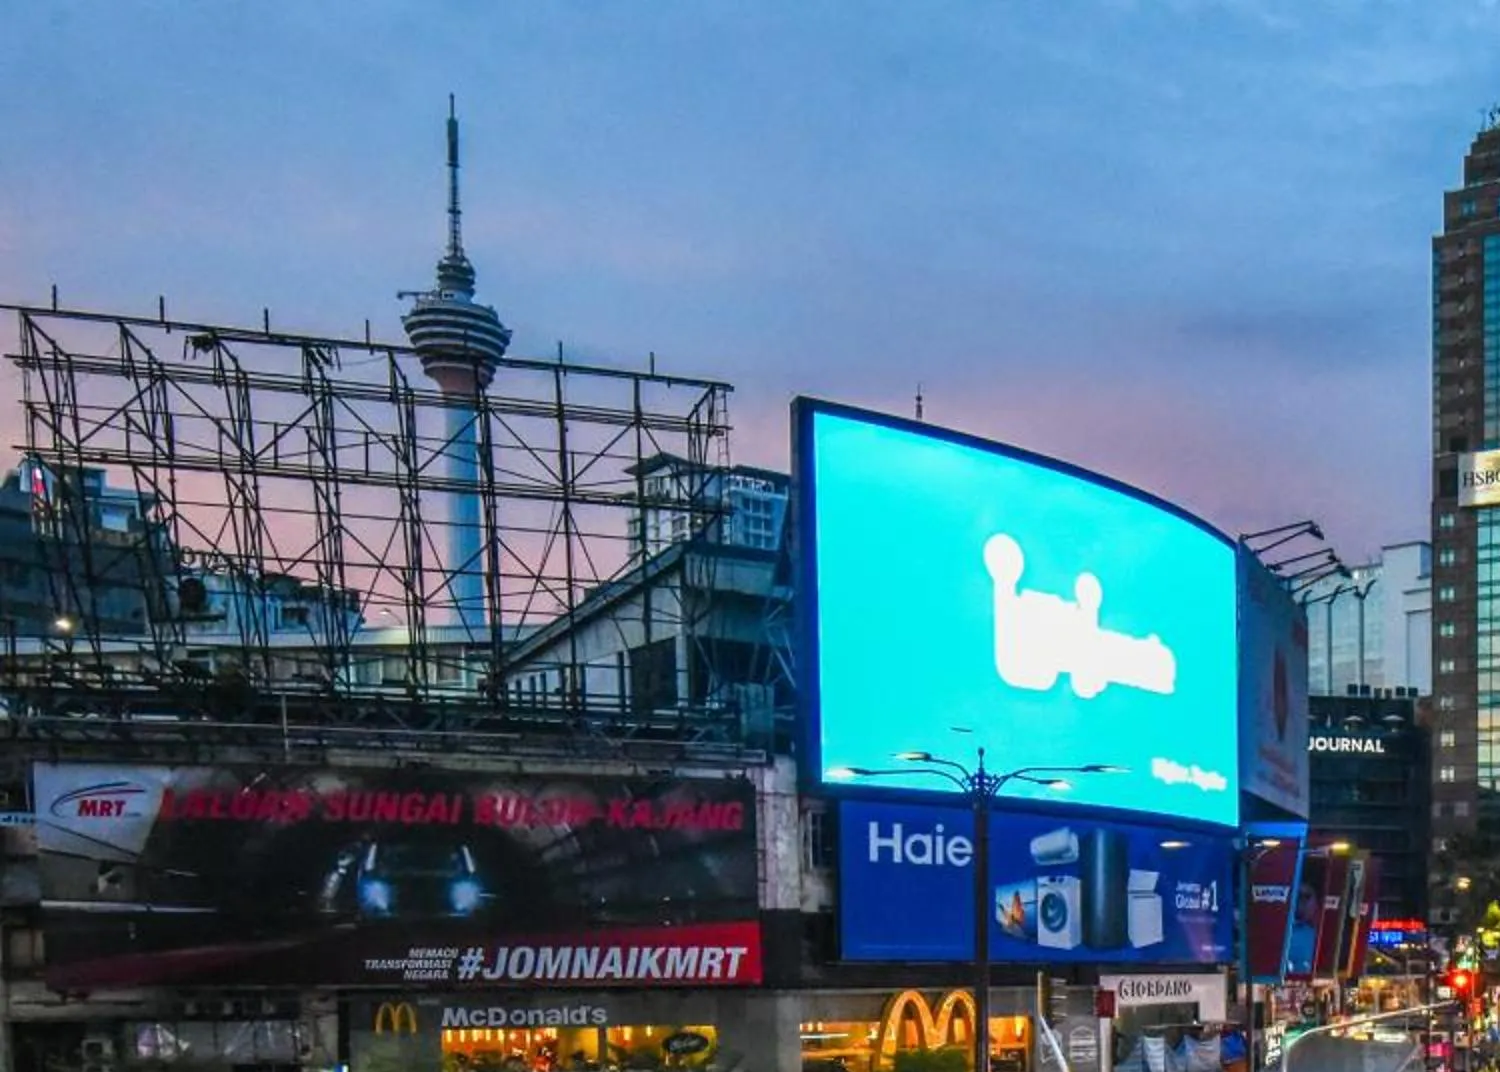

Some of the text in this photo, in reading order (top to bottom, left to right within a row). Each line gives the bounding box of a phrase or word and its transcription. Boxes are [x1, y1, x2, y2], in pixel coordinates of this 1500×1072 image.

[1307, 736, 1386, 754] JOURNAL
[76, 799, 127, 818] MRT
[322, 787, 463, 827] SUNGAI
[868, 821, 974, 868] Haie
[456, 946, 749, 982] #JOMNAIKMRT
[1118, 979, 1193, 1000] GIORDANO
[441, 1005, 609, 1027] McDonald's
